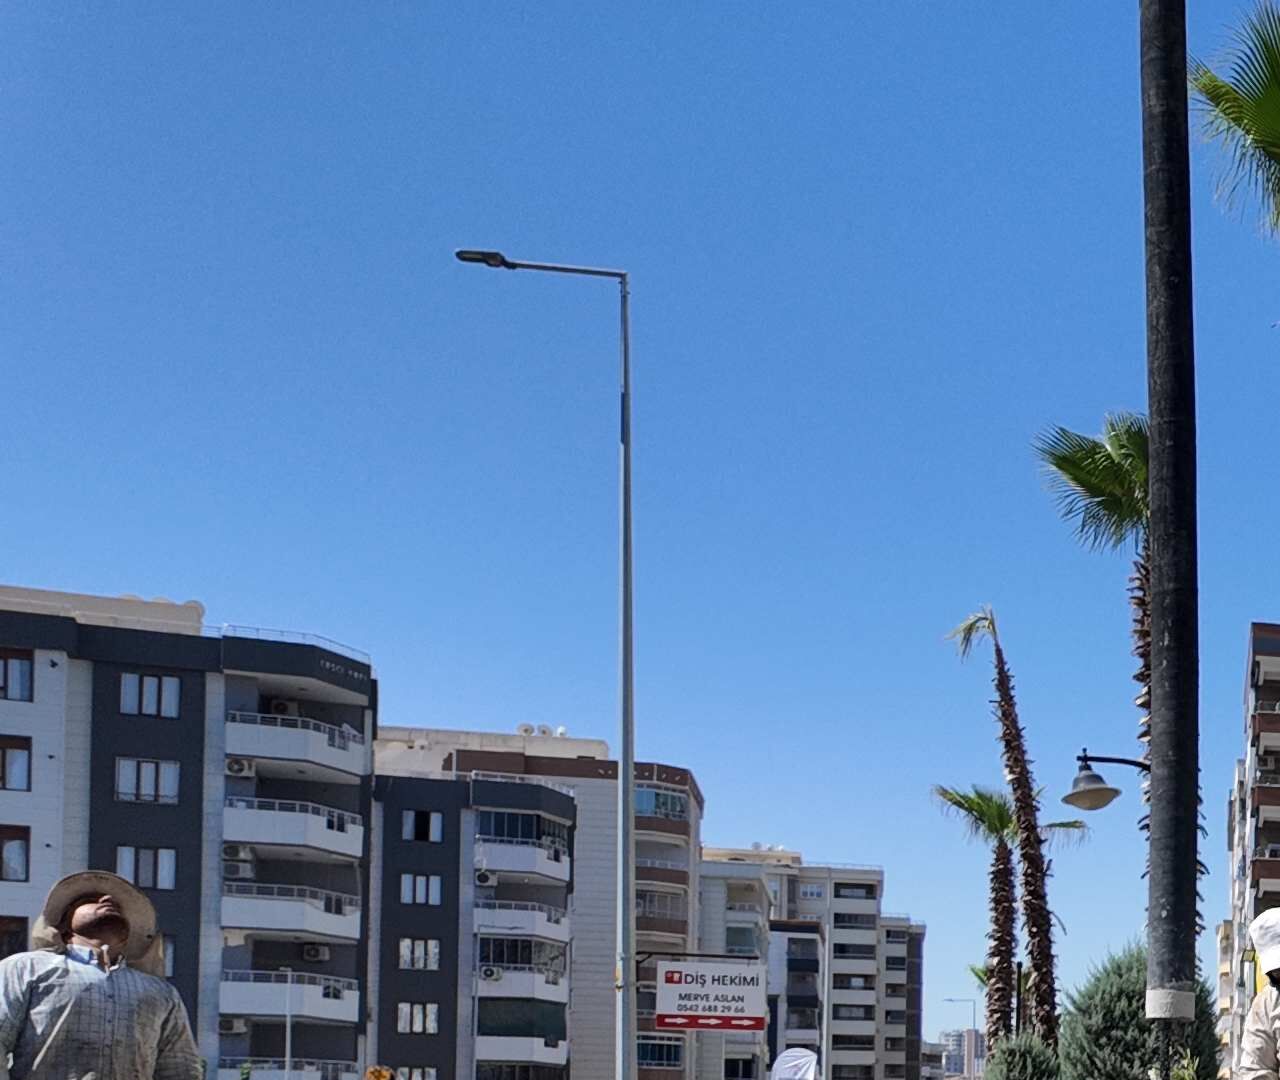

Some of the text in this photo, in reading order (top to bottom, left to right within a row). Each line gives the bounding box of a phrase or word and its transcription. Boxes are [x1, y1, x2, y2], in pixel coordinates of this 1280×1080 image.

[684, 970, 760, 988] DİŞ HEKİMİ
[678, 993, 745, 1003] MERVE ASLAN
